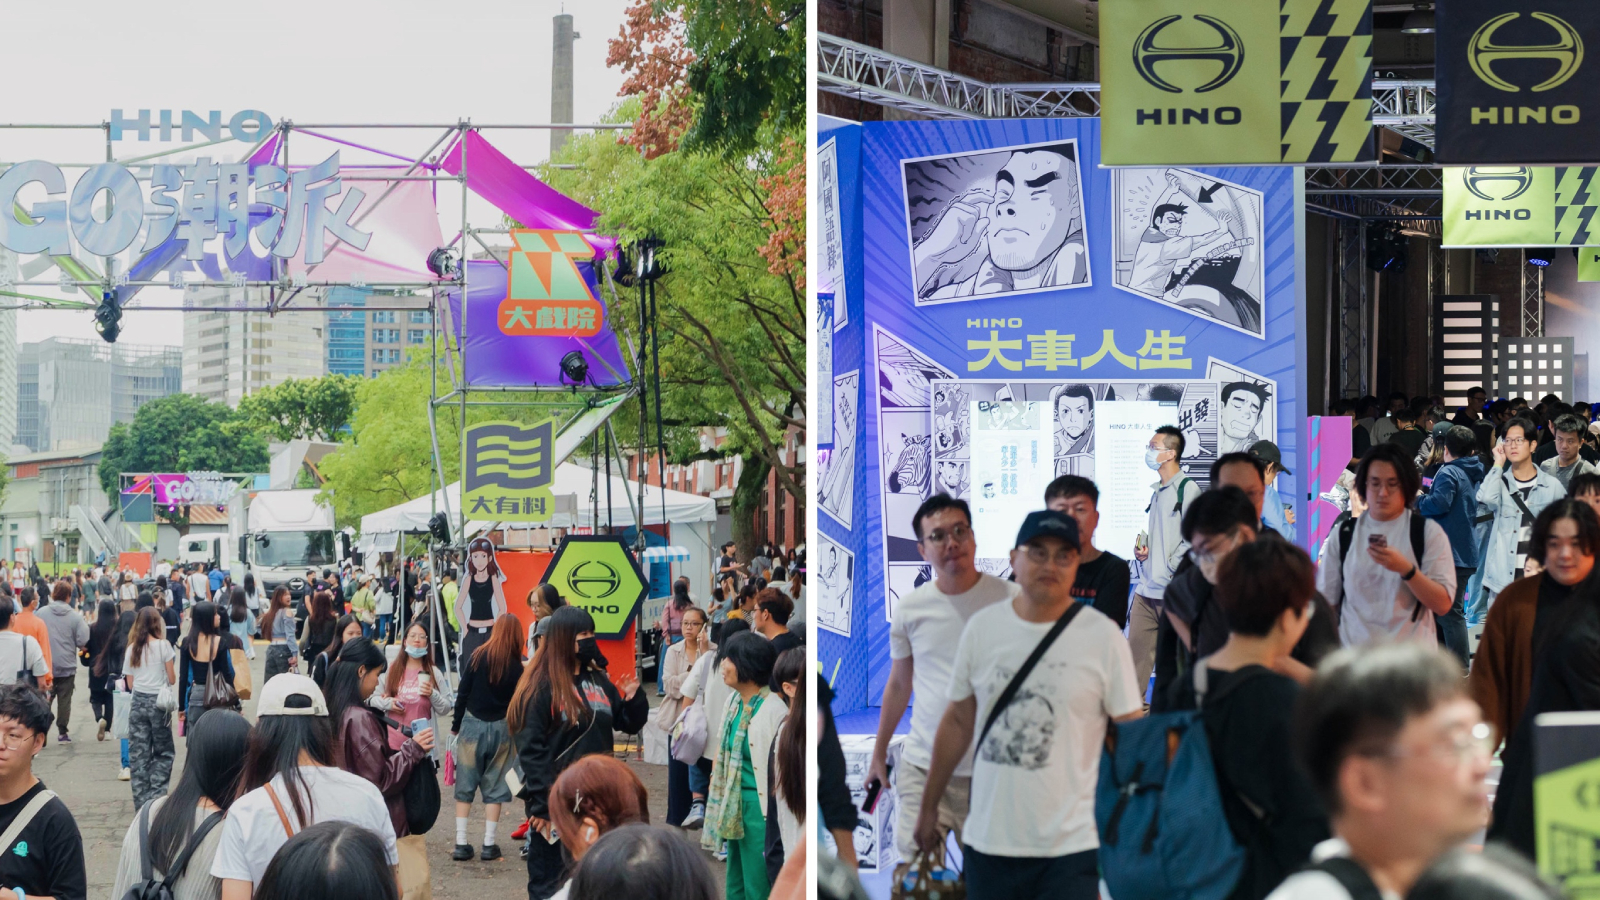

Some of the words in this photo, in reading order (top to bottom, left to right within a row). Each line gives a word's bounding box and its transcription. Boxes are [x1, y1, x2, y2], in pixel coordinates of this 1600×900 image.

[110, 108, 273, 143] HINO
[1136, 106, 1243, 126] HINO
[1470, 104, 1581, 126] HINO
[1465, 208, 1532, 221] HINO
[504, 306, 596, 330] 大戲院
[966, 318, 1023, 329] HINO
[966, 329, 1193, 371] 大車人生
[469, 495, 547, 515] 大有料
